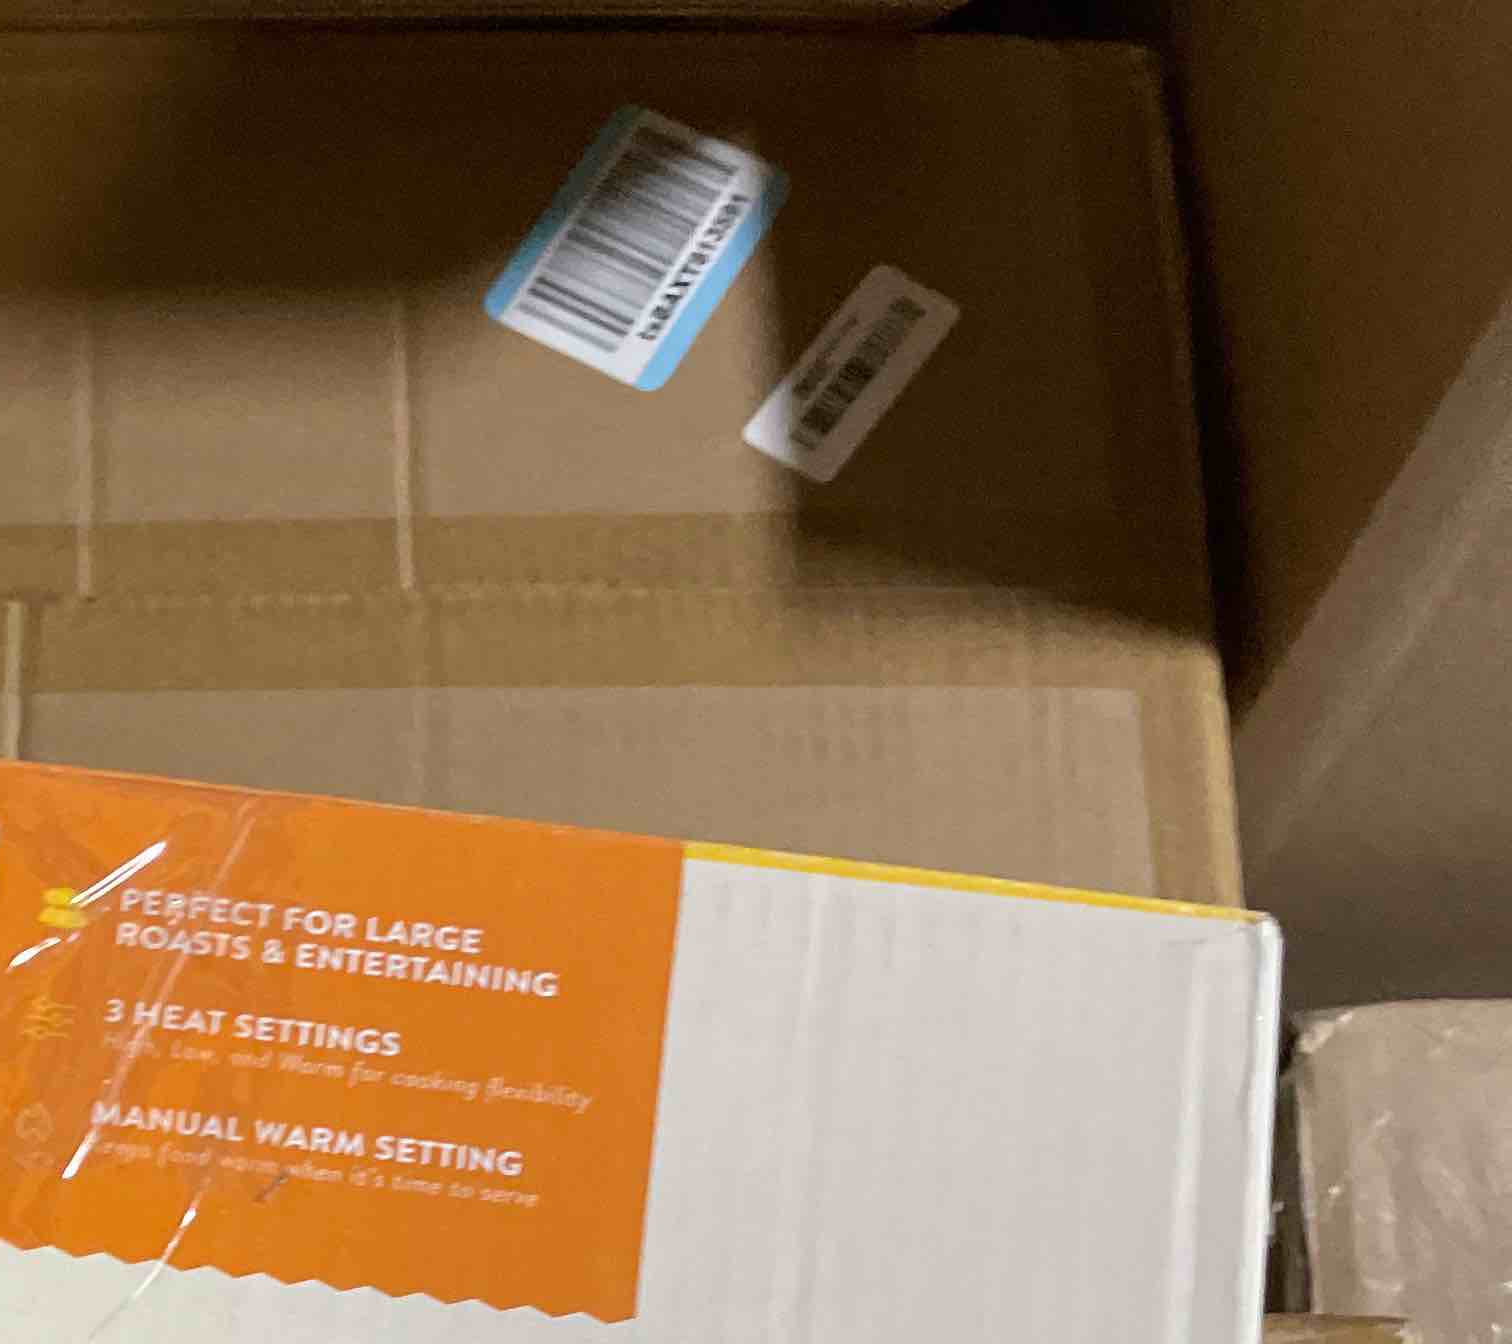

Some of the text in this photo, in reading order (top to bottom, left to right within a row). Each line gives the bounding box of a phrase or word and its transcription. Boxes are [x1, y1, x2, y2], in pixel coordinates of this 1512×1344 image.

[119, 887, 486, 955] PERFECT FOR LARGE
[115, 921, 561, 999] ROASTS & ENTERTAINING
[103, 999, 402, 1057] 3 HEAT SETTINGS
[90, 1100, 525, 1177] MANUAL WARM SETTING
